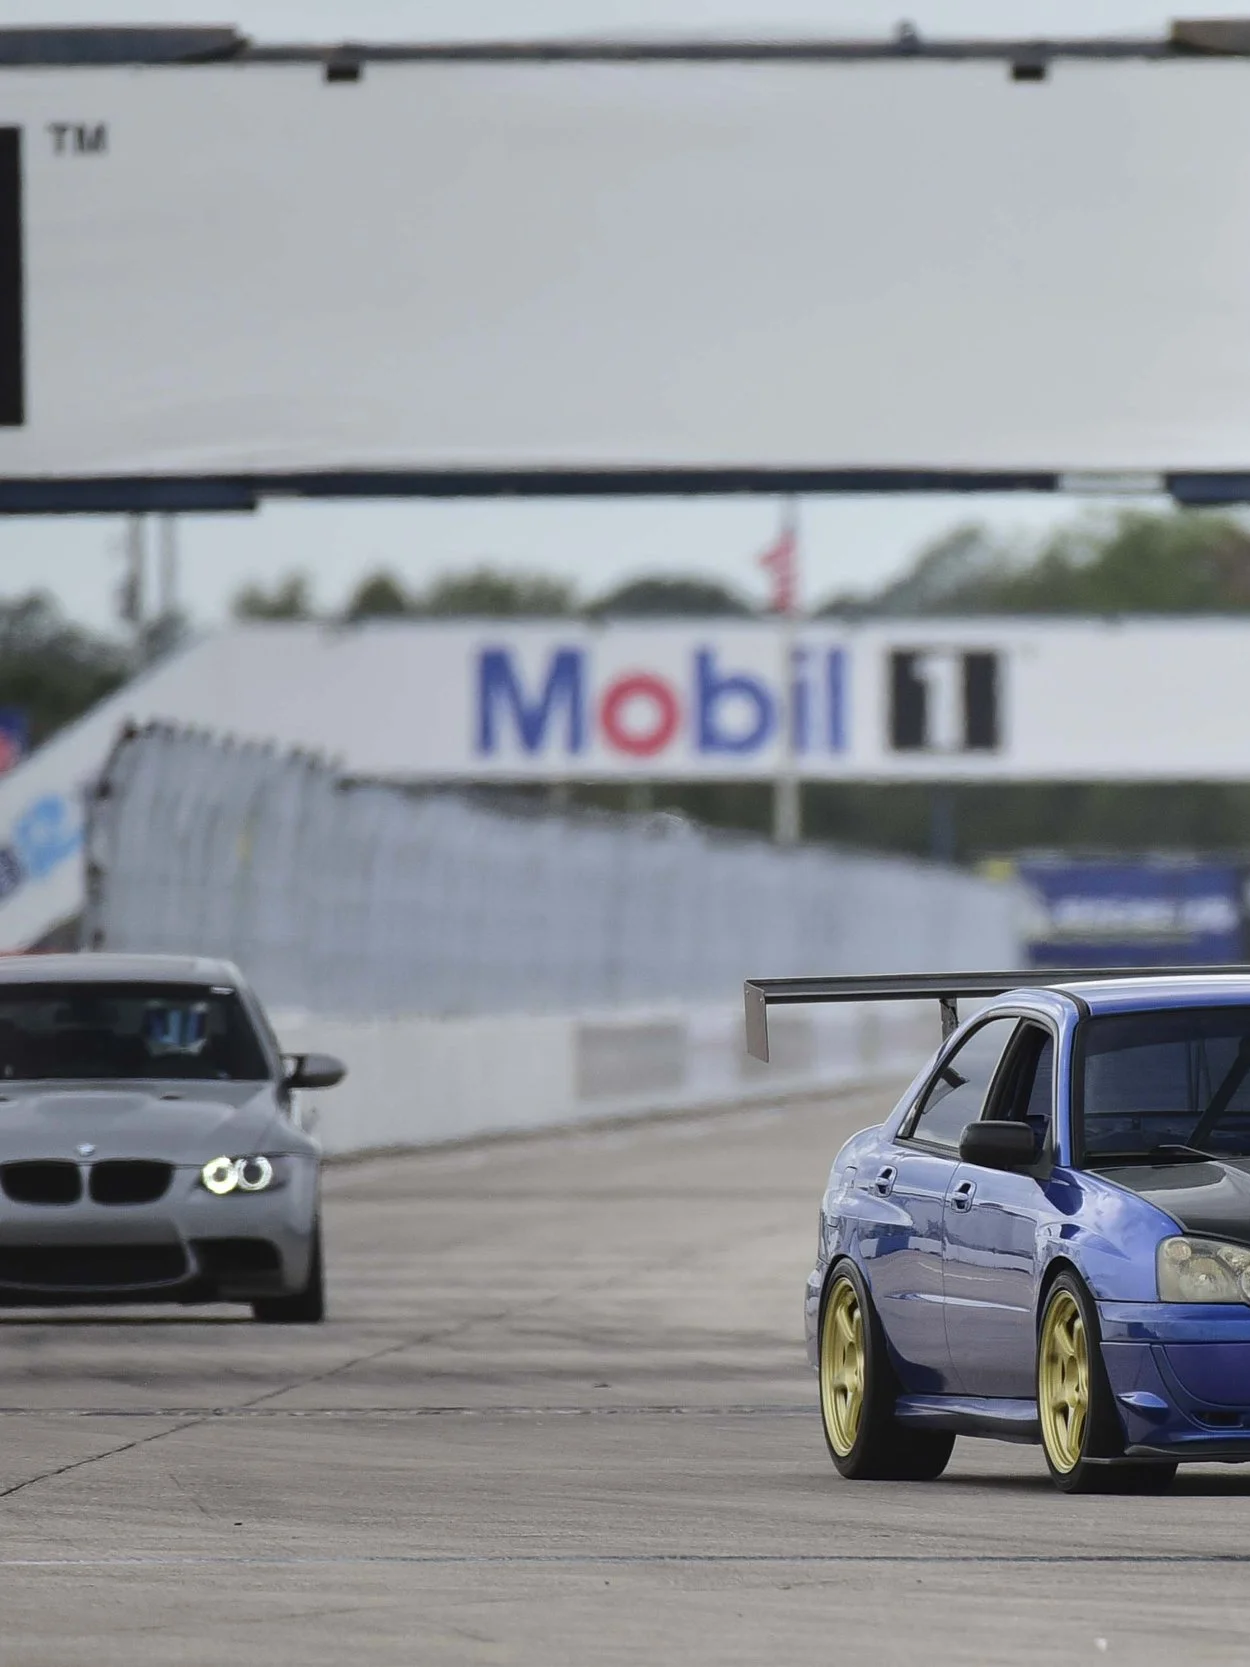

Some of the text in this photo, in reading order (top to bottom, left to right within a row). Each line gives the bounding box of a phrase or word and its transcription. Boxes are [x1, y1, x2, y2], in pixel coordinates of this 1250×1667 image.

[48, 121, 107, 156] TM
[478, 646, 970, 757] Mobil 1
